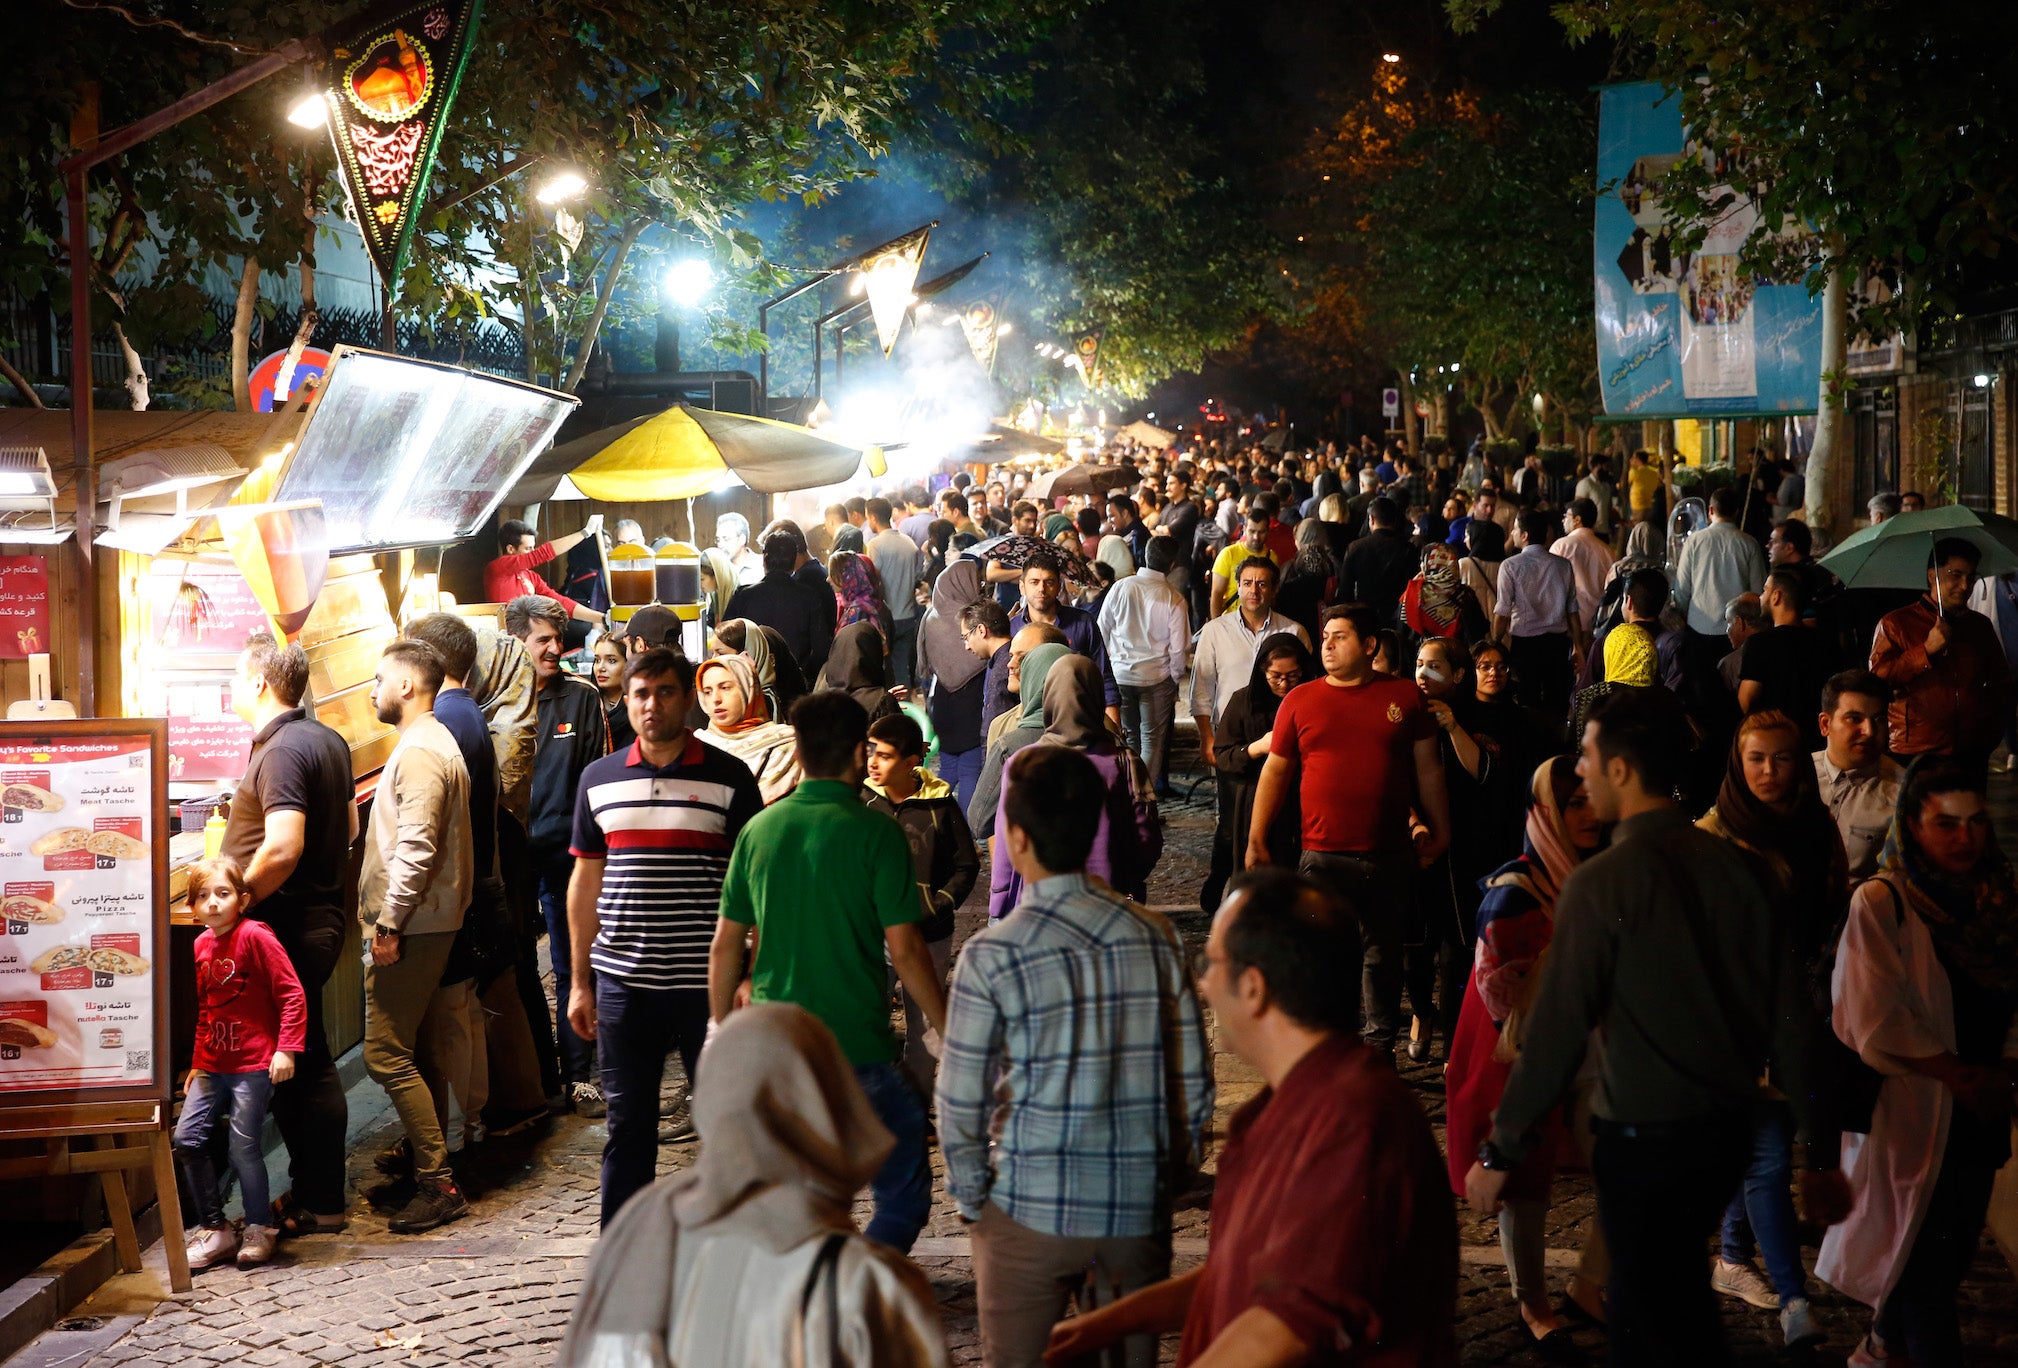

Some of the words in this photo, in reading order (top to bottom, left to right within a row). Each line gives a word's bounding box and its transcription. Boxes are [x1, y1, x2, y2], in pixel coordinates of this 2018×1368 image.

[0, 566, 12, 575] خر
[14, 565, 39, 575] هنگام
[0, 592, 15, 601] علاو
[18, 594, 23, 602] و
[26, 592, 45, 601] کنید
[14, 607, 36, 617] قرعه
[0, 746, 14, 754] y's
[17, 745, 58, 753] Favorite
[60, 744, 119, 752] Sandwiches
[199, 750, 216, 758] کنید
[216, 750, 240, 758] شرکت
[80, 786, 111, 796] گوشت
[97, 859, 108, 867] 17
[100, 894, 120, 904] پیتزا
[9, 925, 21, 933] 17
[95, 978, 107, 986] 17
[108, 1001, 131, 1009] تاشه
[77, 1013, 107, 1022] nutella
